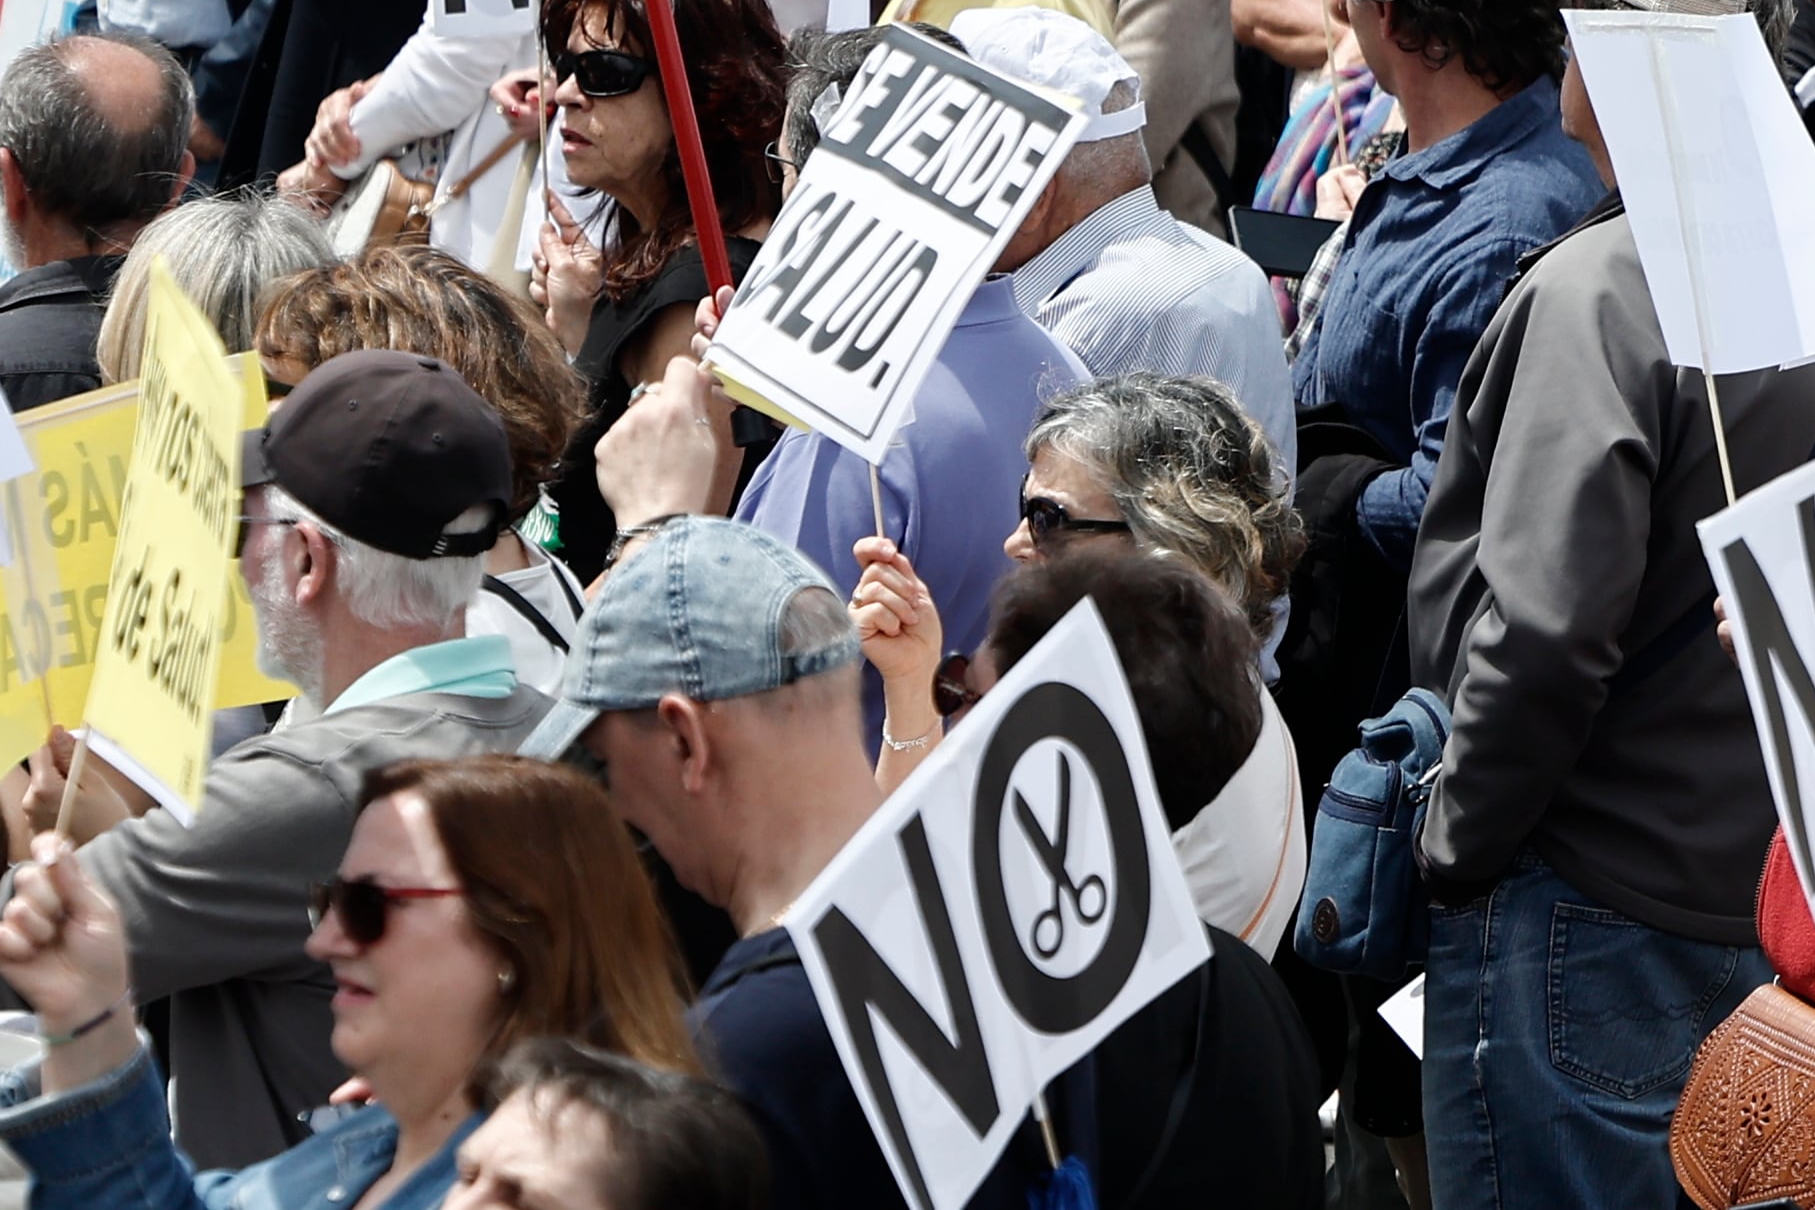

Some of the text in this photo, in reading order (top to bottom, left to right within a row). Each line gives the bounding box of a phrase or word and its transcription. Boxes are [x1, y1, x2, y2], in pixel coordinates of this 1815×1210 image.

[875, 65, 1059, 226] VENDE
[111, 545, 152, 666] de
[812, 680, 1151, 1210] NO
